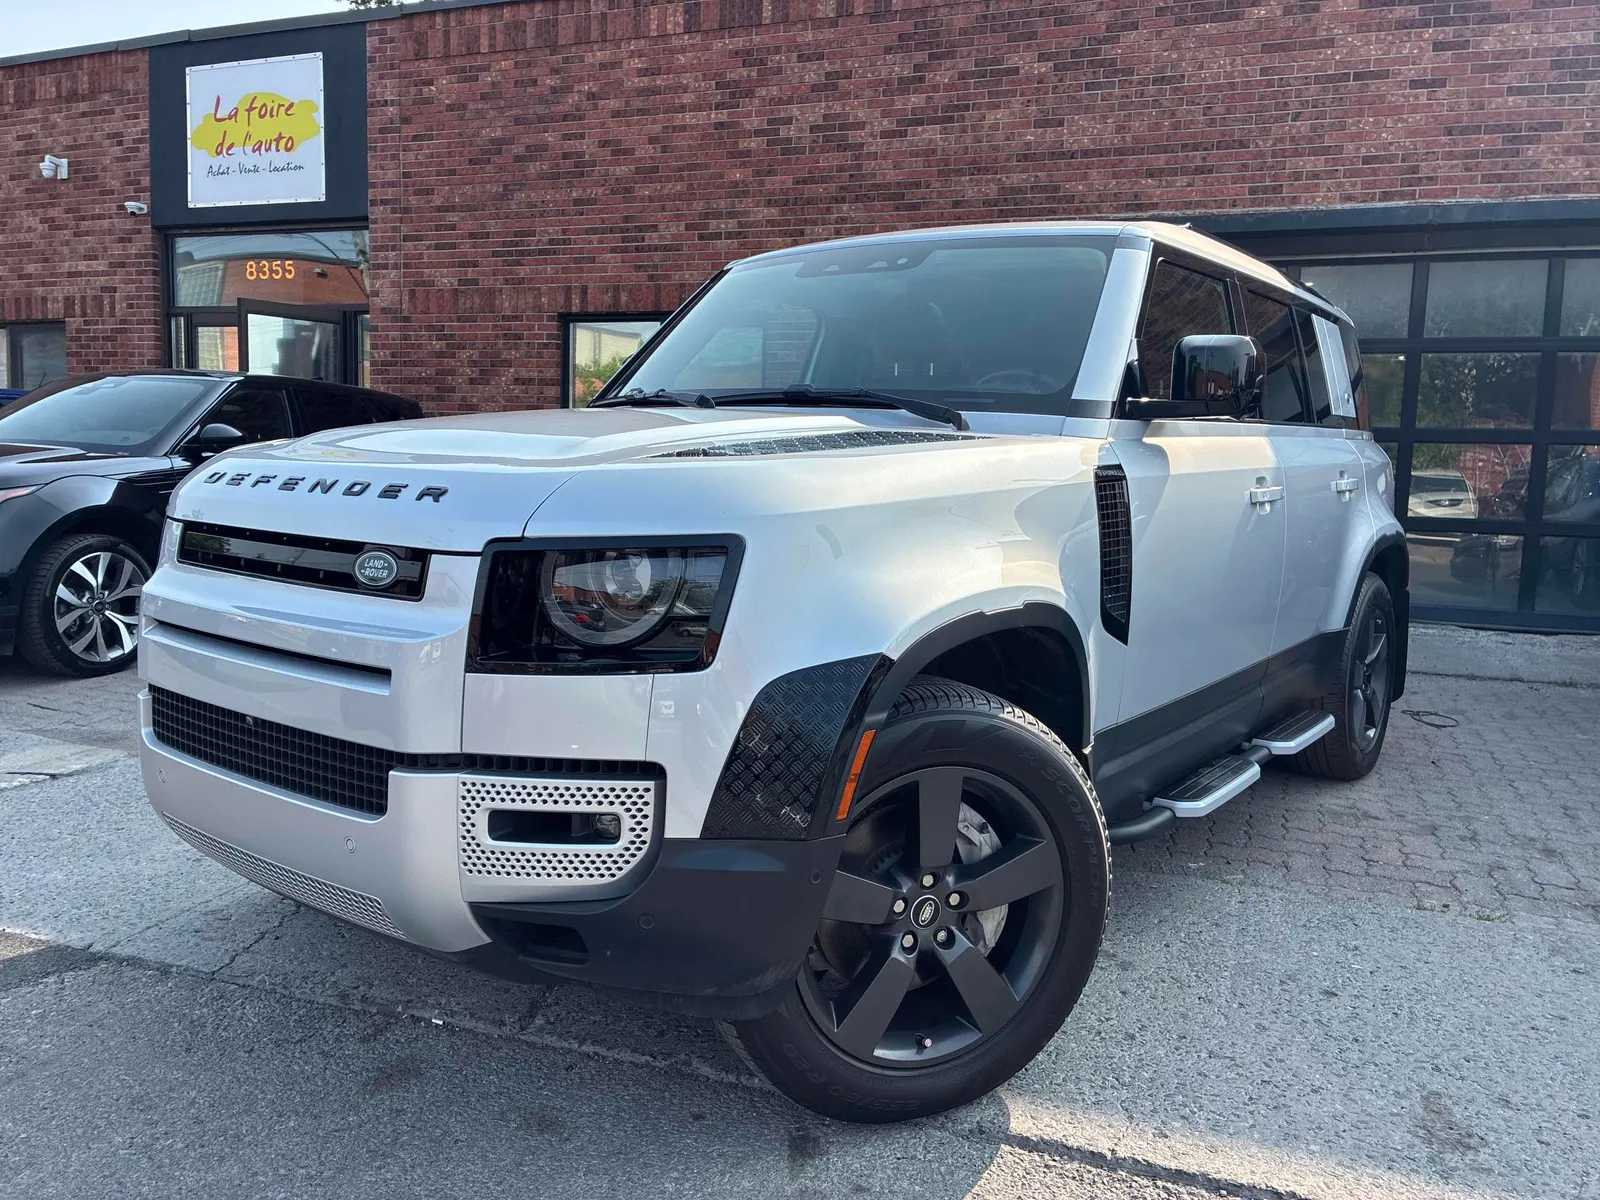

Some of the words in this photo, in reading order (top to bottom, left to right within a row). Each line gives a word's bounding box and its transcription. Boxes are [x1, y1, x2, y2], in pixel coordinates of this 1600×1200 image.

[213, 95, 239, 123] La
[244, 95, 296, 127] foire
[215, 130, 236, 158] de
[242, 131, 295, 156] l'auto
[206, 164, 230, 178] Achat
[238, 161, 260, 175] Vente
[268, 160, 305, 173] Location
[245, 260, 295, 280] 8355
[203, 471, 449, 503] DEFENDER
